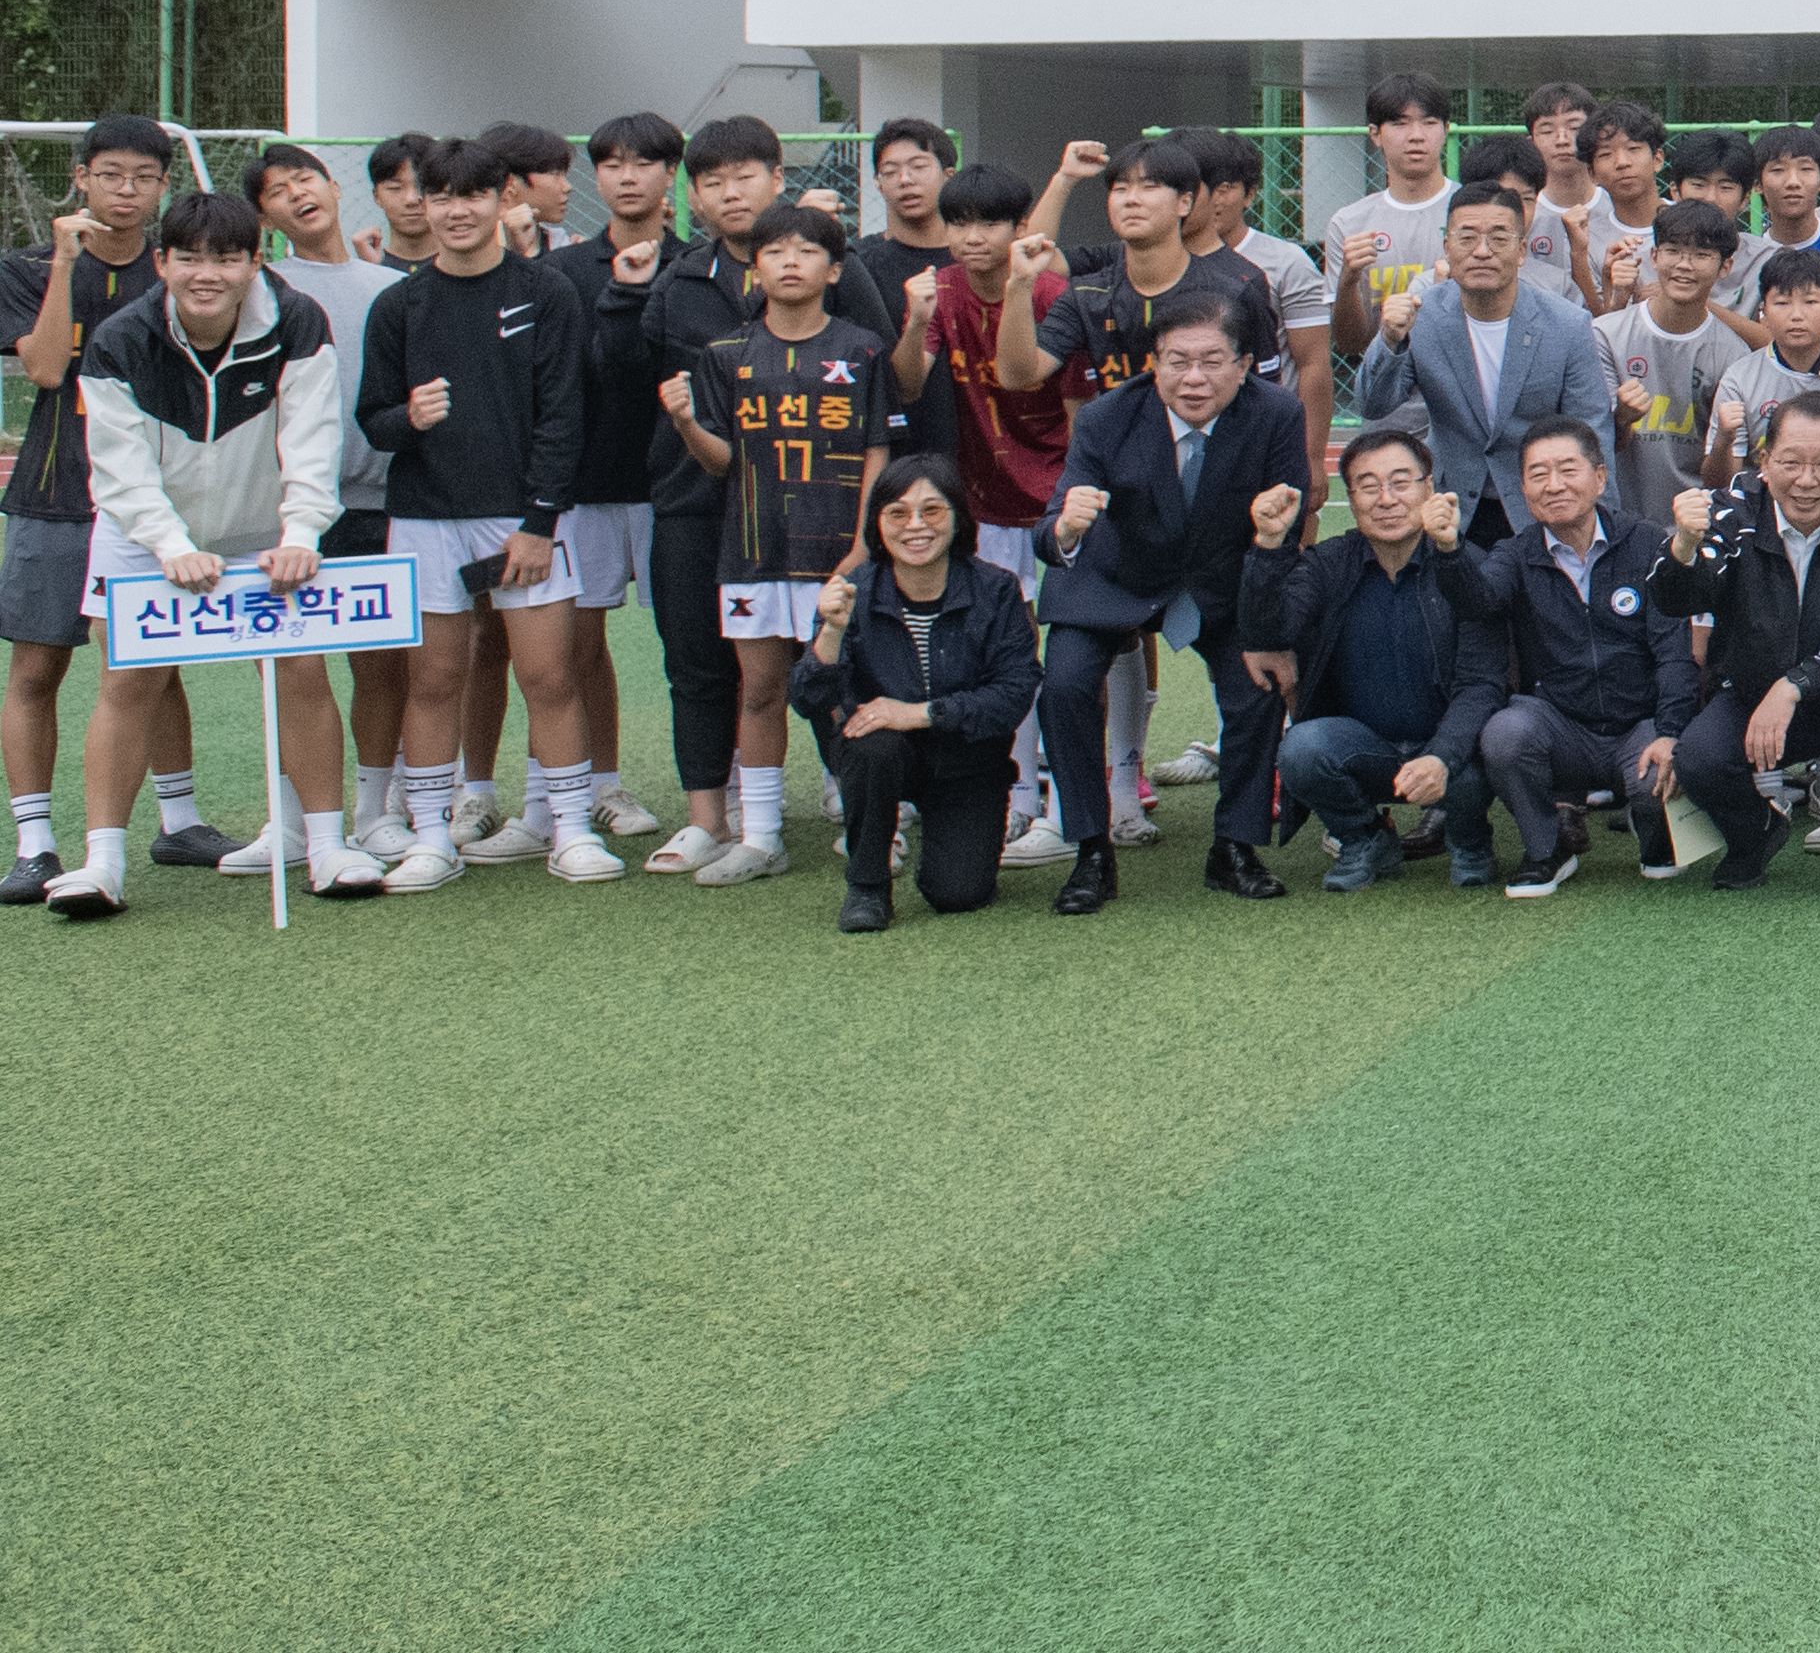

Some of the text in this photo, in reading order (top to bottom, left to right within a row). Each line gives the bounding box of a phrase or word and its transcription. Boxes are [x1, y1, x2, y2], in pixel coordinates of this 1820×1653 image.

[735, 394, 853, 430] 신선중
[773, 439, 813, 482] 17
[136, 582, 393, 640] 신선중학교
